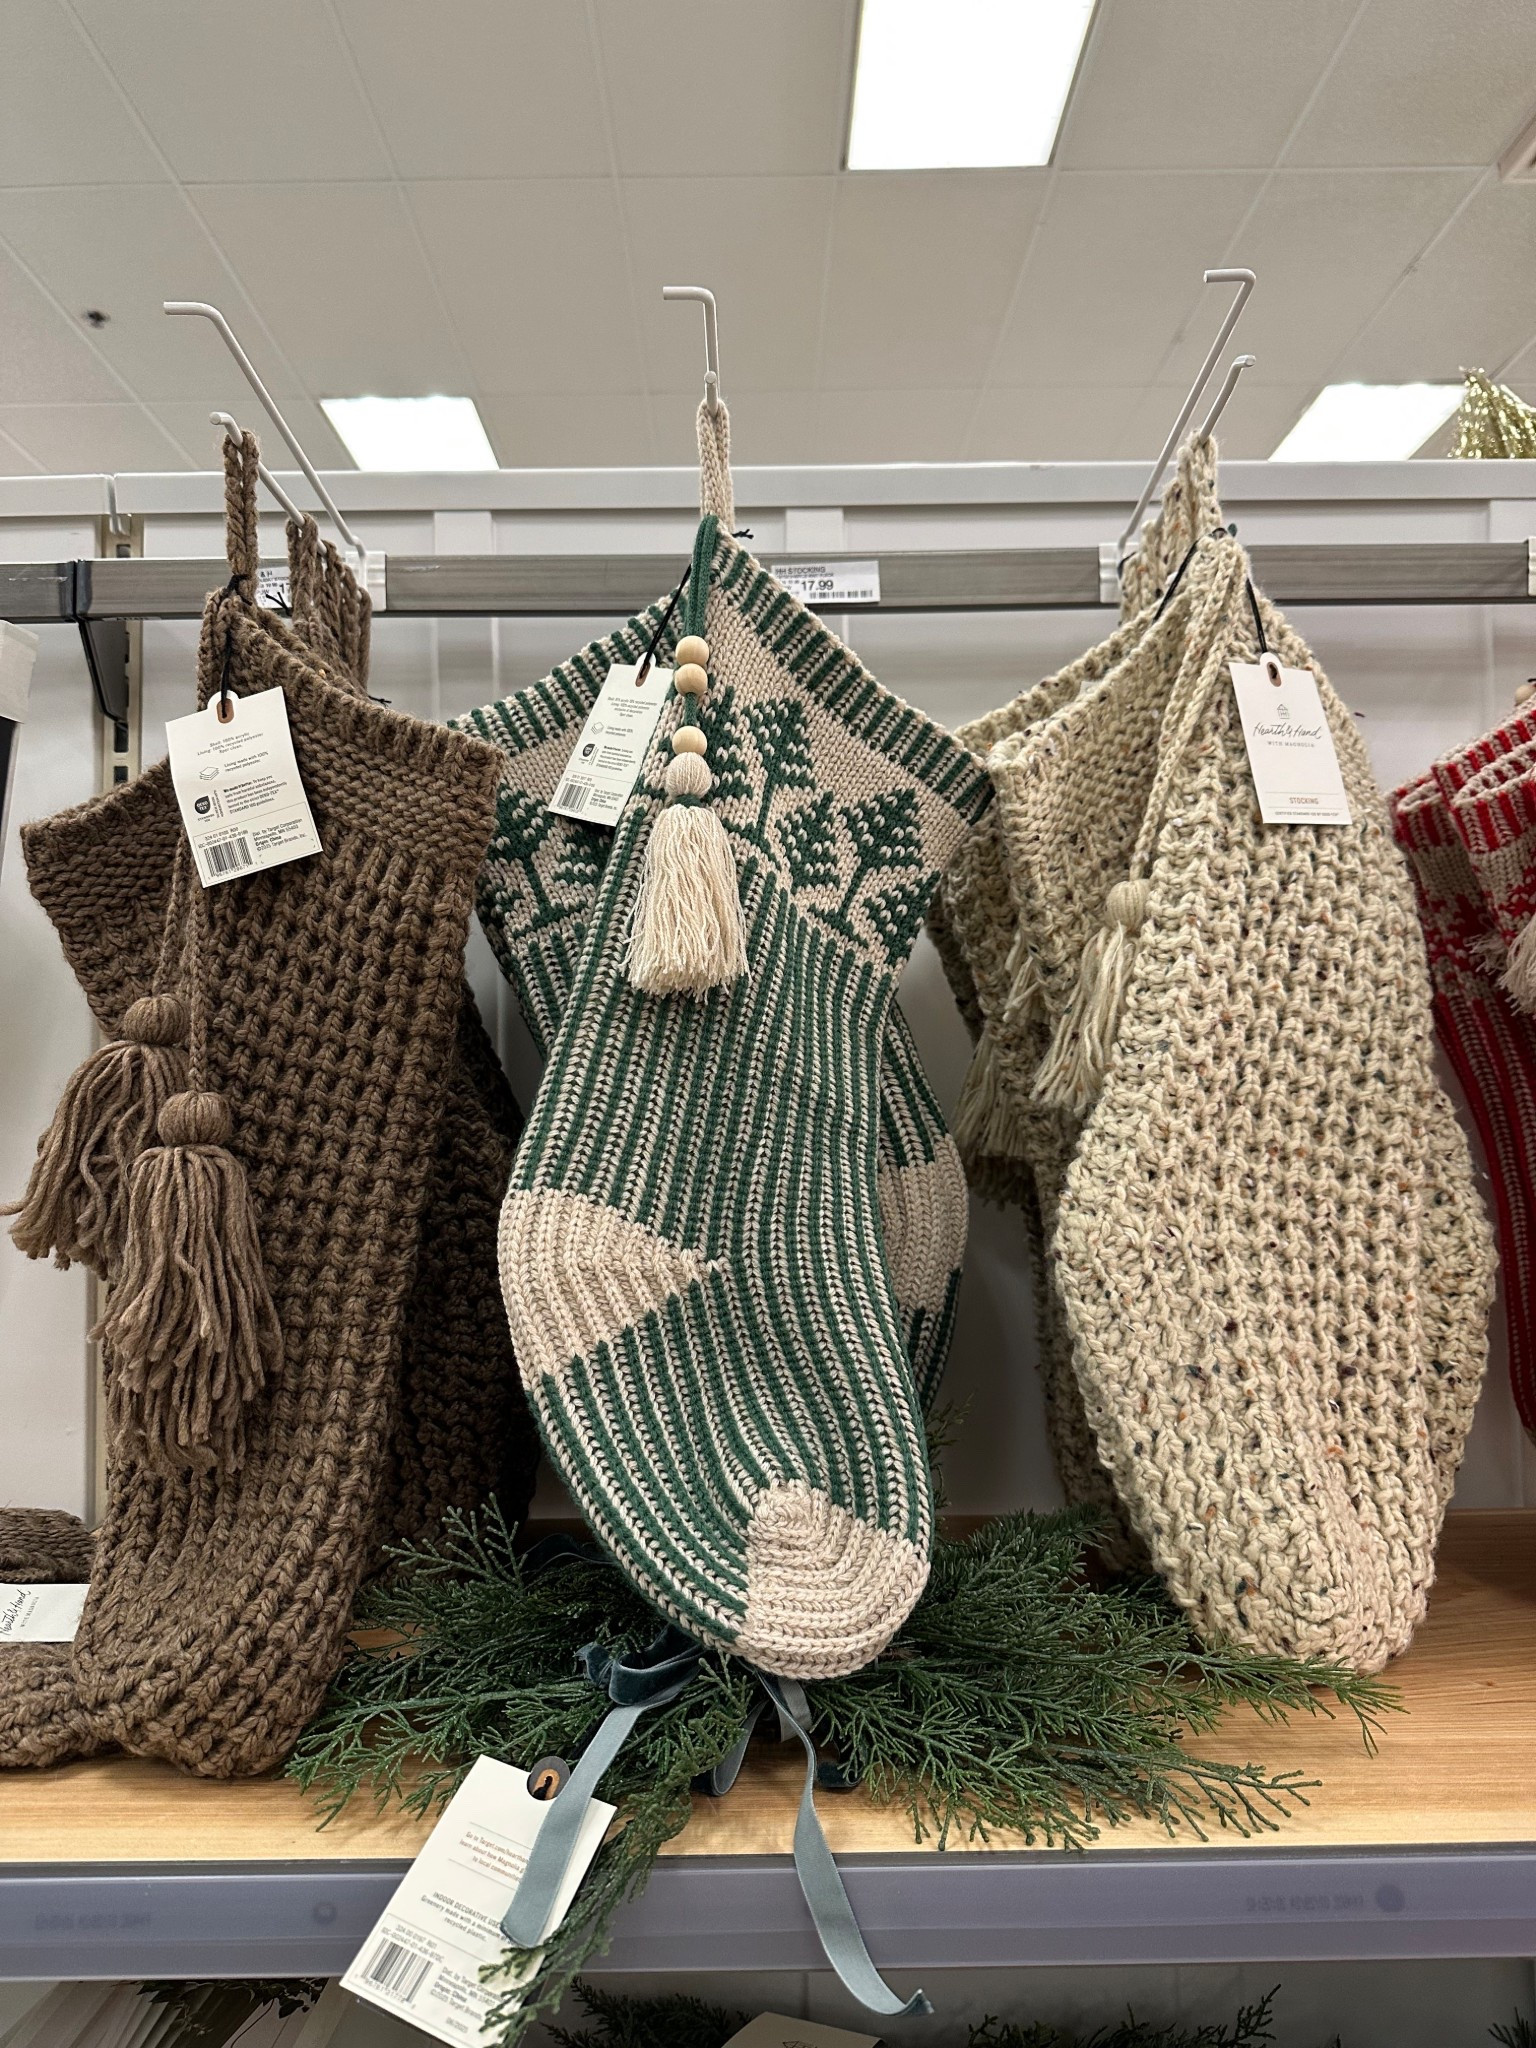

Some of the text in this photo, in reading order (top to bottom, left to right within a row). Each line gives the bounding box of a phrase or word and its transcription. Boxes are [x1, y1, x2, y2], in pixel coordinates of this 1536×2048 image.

[775, 566, 826, 575] HH STOCKING
[801, 580, 834, 591] 17.99
[1253, 722, 1287, 737] Hearth
[1293, 725, 1322, 740] Hand
[1289, 797, 1319, 805] STOCKING
[267, 824, 279, 832] Target
[279, 817, 302, 828] Corporation
[269, 834, 281, 842] China
[271, 839, 283, 847] Target
[472, 1845, 487, 1855] about
[497, 1855, 520, 1870] Magnolia
[432, 1891, 455, 1905] INDOOR
[453, 1901, 488, 1922] DECORATIVE
[420, 1894, 445, 1911] Greenery
[444, 1907, 460, 1918] made
[459, 1914, 472, 1924] with
[476, 1923, 500, 1938] minimum
[443, 1916, 468, 1931] recycled
[459, 1975, 478, 1989] Target
[447, 1997, 465, 2011] Target
